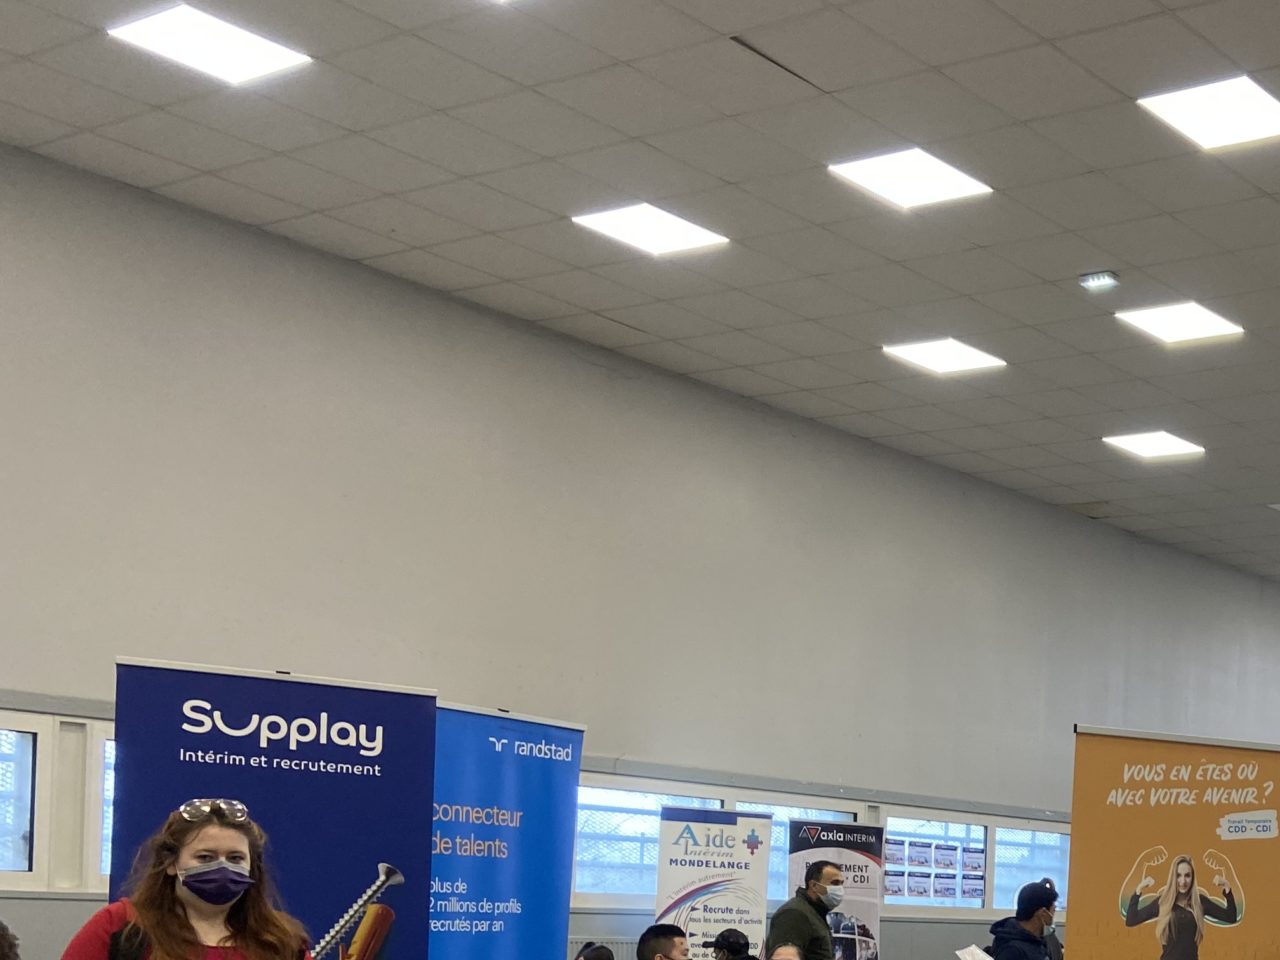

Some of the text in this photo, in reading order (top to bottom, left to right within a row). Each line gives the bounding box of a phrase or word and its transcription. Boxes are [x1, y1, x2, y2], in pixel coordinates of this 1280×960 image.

[181, 699, 384, 757] Supplay
[514, 740, 572, 762] randstad
[179, 748, 382, 776] Intérim et recrutement
[1123, 758, 1259, 784] VOUS EN ÊTES OÙ
[1106, 780, 1275, 808] AVEC VOTRE AVENIR ?
[432, 803, 524, 828] connecteur
[671, 823, 736, 849] Aide
[820, 829, 876, 843] axia INTERIM
[1227, 825, 1248, 834] CDD
[1255, 824, 1272, 833] CDI
[431, 830, 509, 859] de talents
[669, 858, 751, 870] MONDELANGE
[453, 878, 468, 894] de
[852, 874, 870, 884] CDI
[437, 897, 477, 913] millions
[479, 898, 493, 913] de
[495, 899, 522, 916] profils
[702, 904, 750, 915] Recrute dans
[473, 920, 490, 935] par
[492, 920, 504, 932] an
